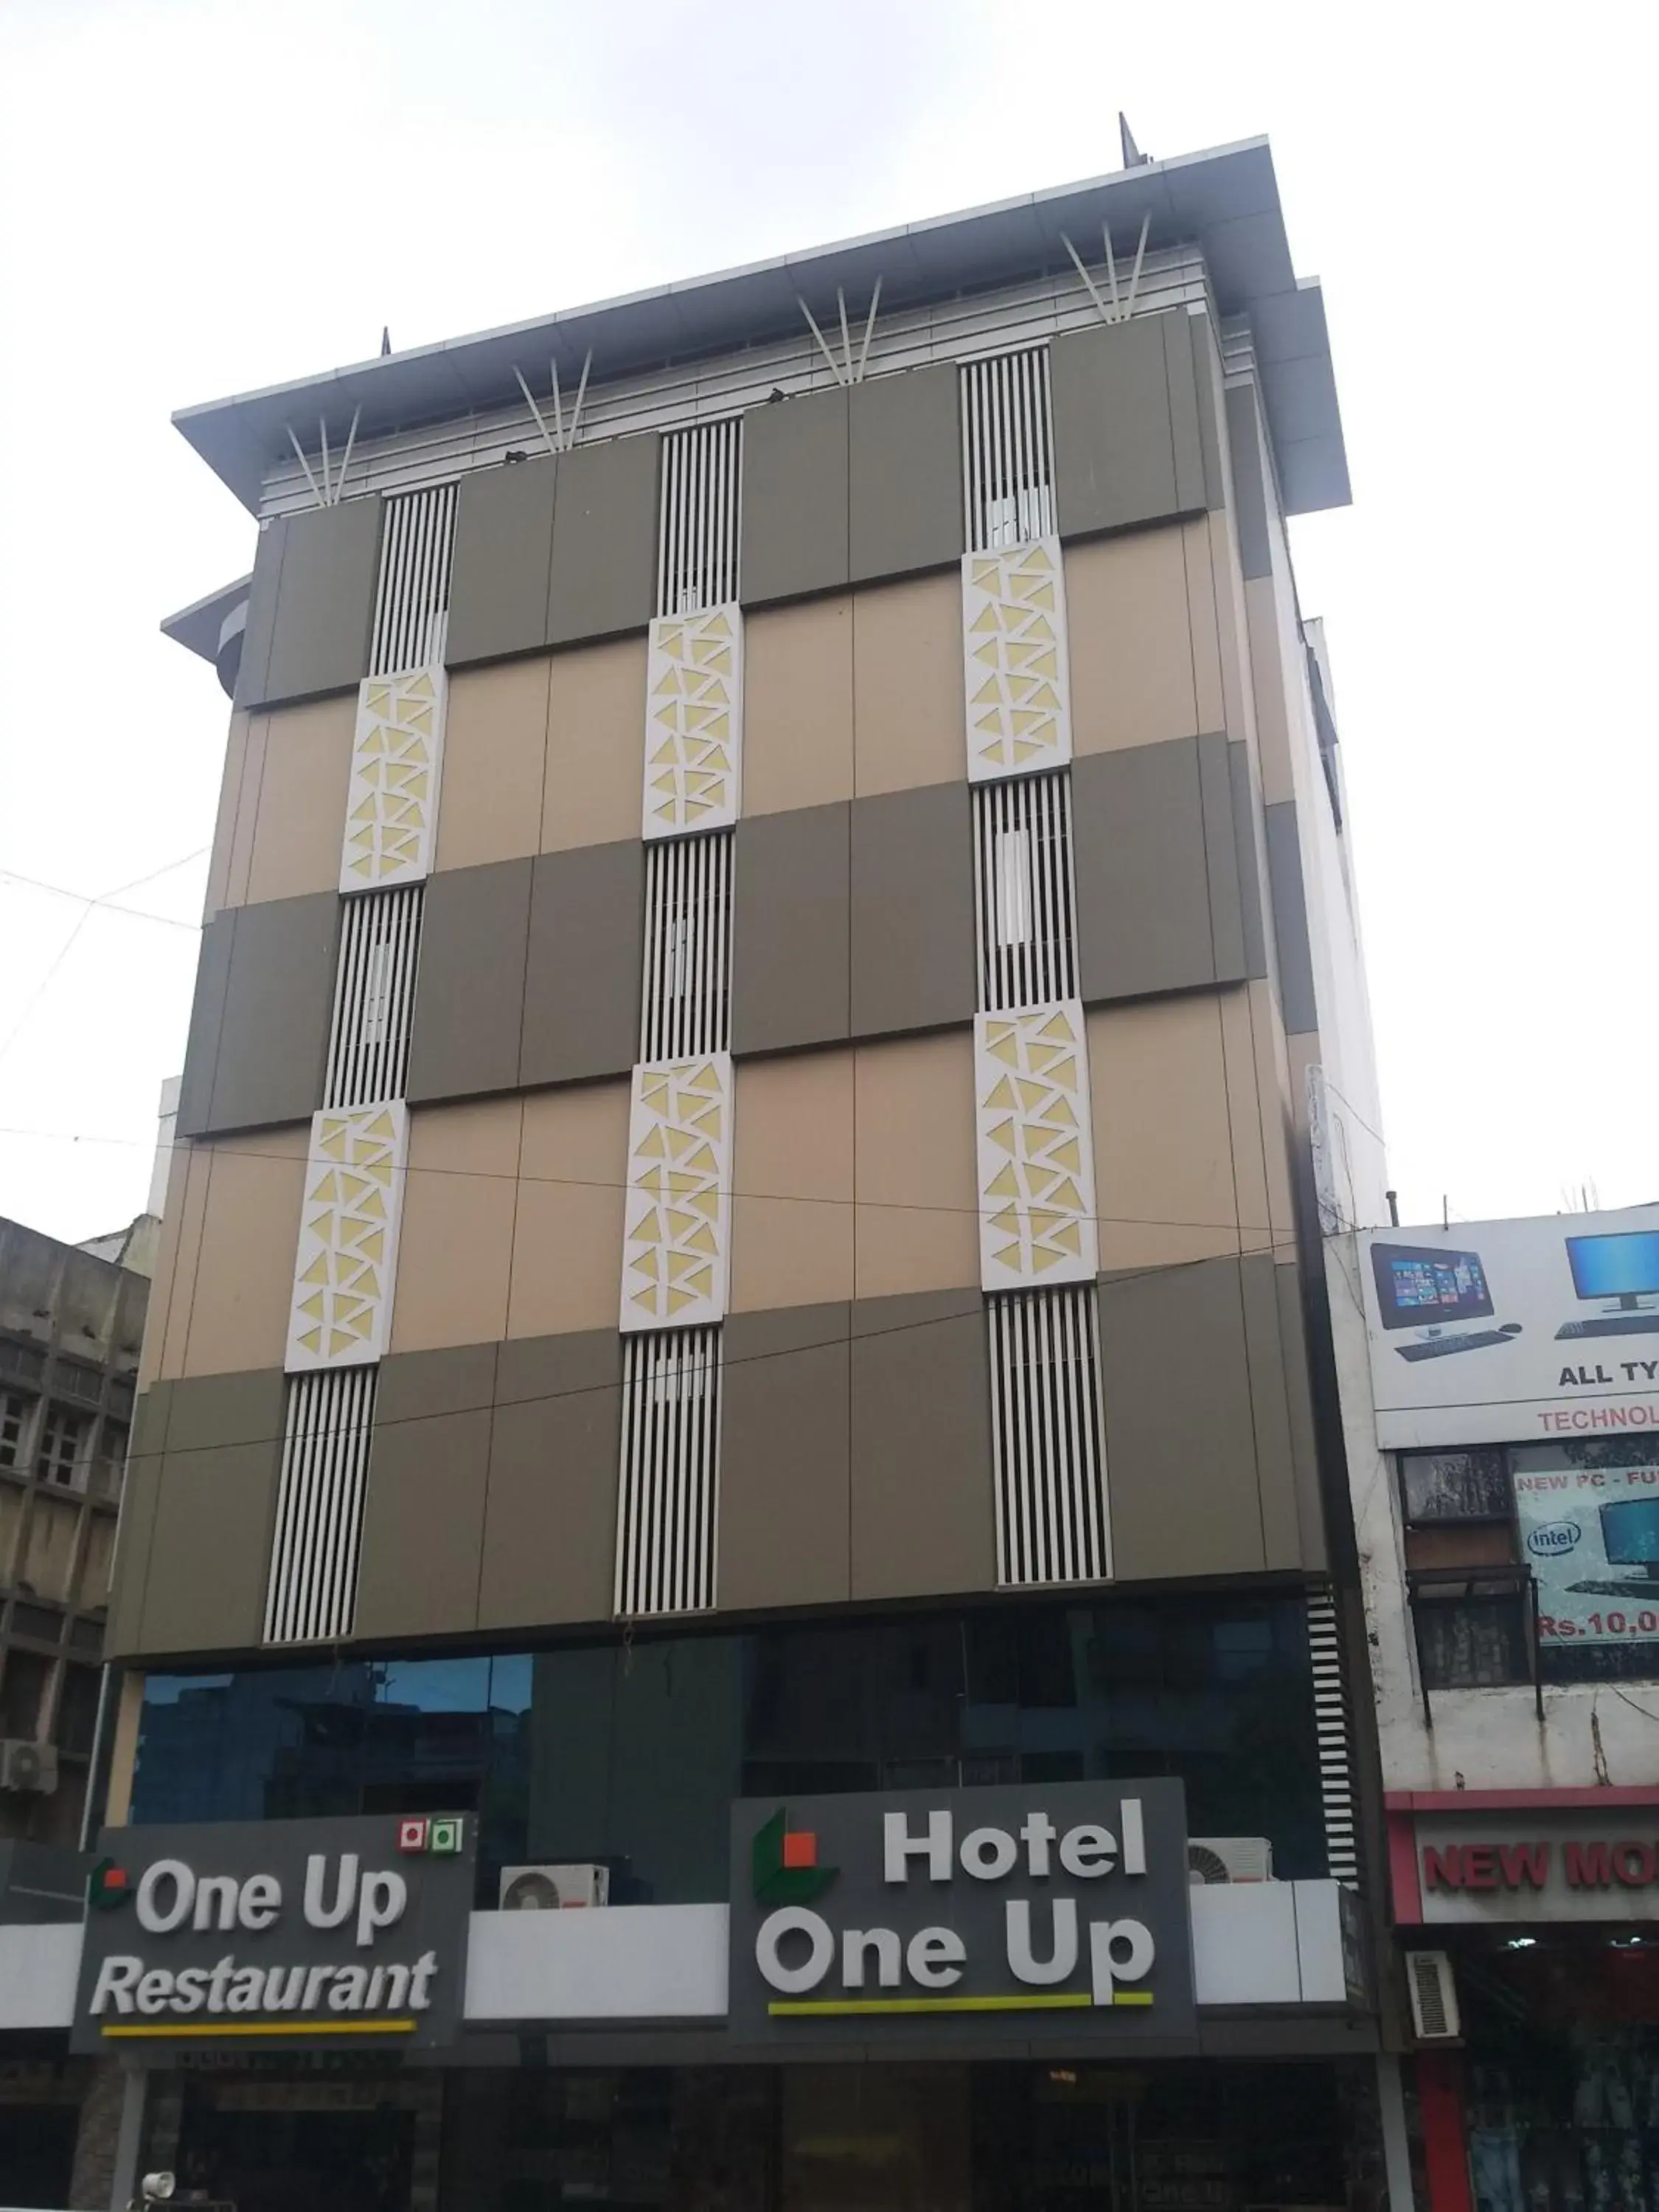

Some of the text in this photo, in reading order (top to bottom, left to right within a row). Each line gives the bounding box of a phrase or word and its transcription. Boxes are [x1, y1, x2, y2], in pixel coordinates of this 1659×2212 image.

[1559, 1365, 1613, 1386] ALL
[1517, 1475, 1568, 1492] NEW
[1576, 1474, 1605, 1489] PC
[1627, 1470, 1659, 1486] FU
[1534, 1528, 1573, 1546] intel
[1537, 1610, 1659, 1637] Rs.10,0
[885, 1798, 1147, 1882] Hotel
[1422, 1839, 1659, 1893] NEW MO
[136, 1854, 407, 1945] One Up
[756, 1898, 1155, 2006] One Up
[88, 1951, 438, 2014] Restaurant
